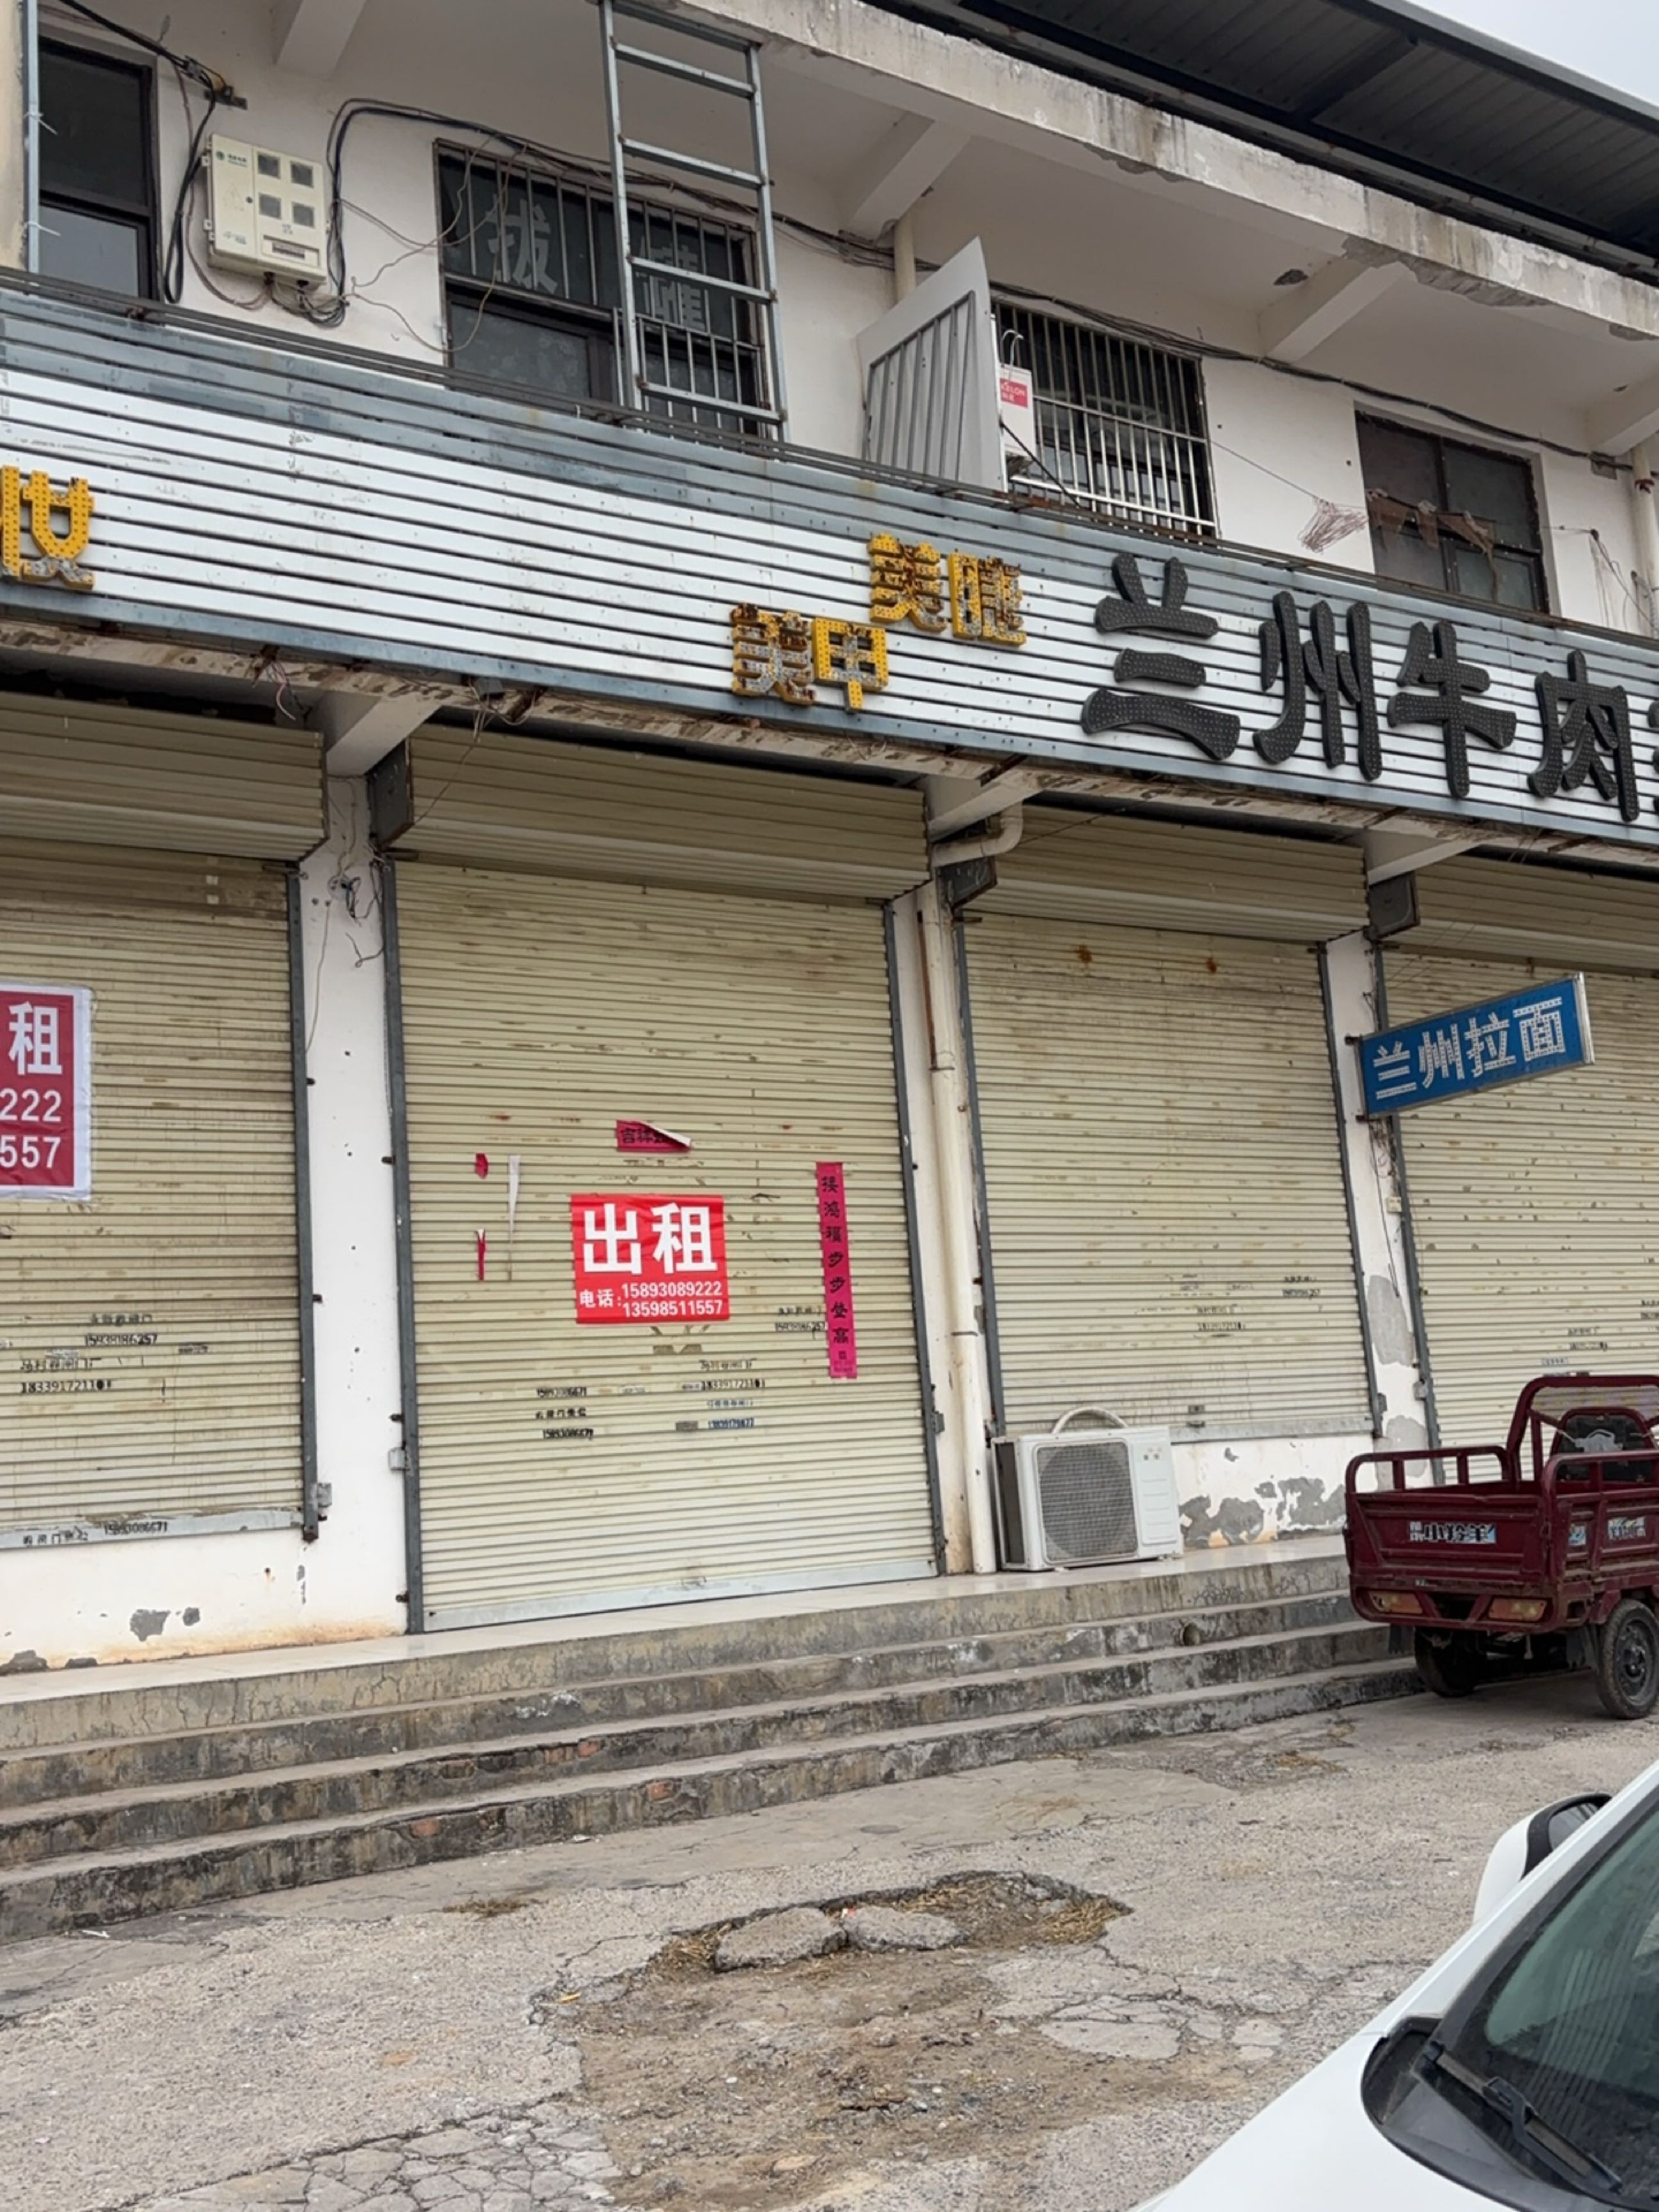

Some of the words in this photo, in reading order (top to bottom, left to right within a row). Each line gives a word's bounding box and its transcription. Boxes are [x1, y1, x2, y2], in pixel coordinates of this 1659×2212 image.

[730, 602, 890, 712] 美甲
[1081, 552, 1659, 822] 兰州牛肉
[8, 1001, 62, 1076] 租
[1373, 997, 1566, 1100] 兰州拉面
[0, 1089, 61, 1122] 222
[0, 1135, 61, 1168] 557
[583, 1203, 717, 1274] 出租
[621, 1281, 723, 1299] 15893089222
[623, 1299, 724, 1318] 13598511557
